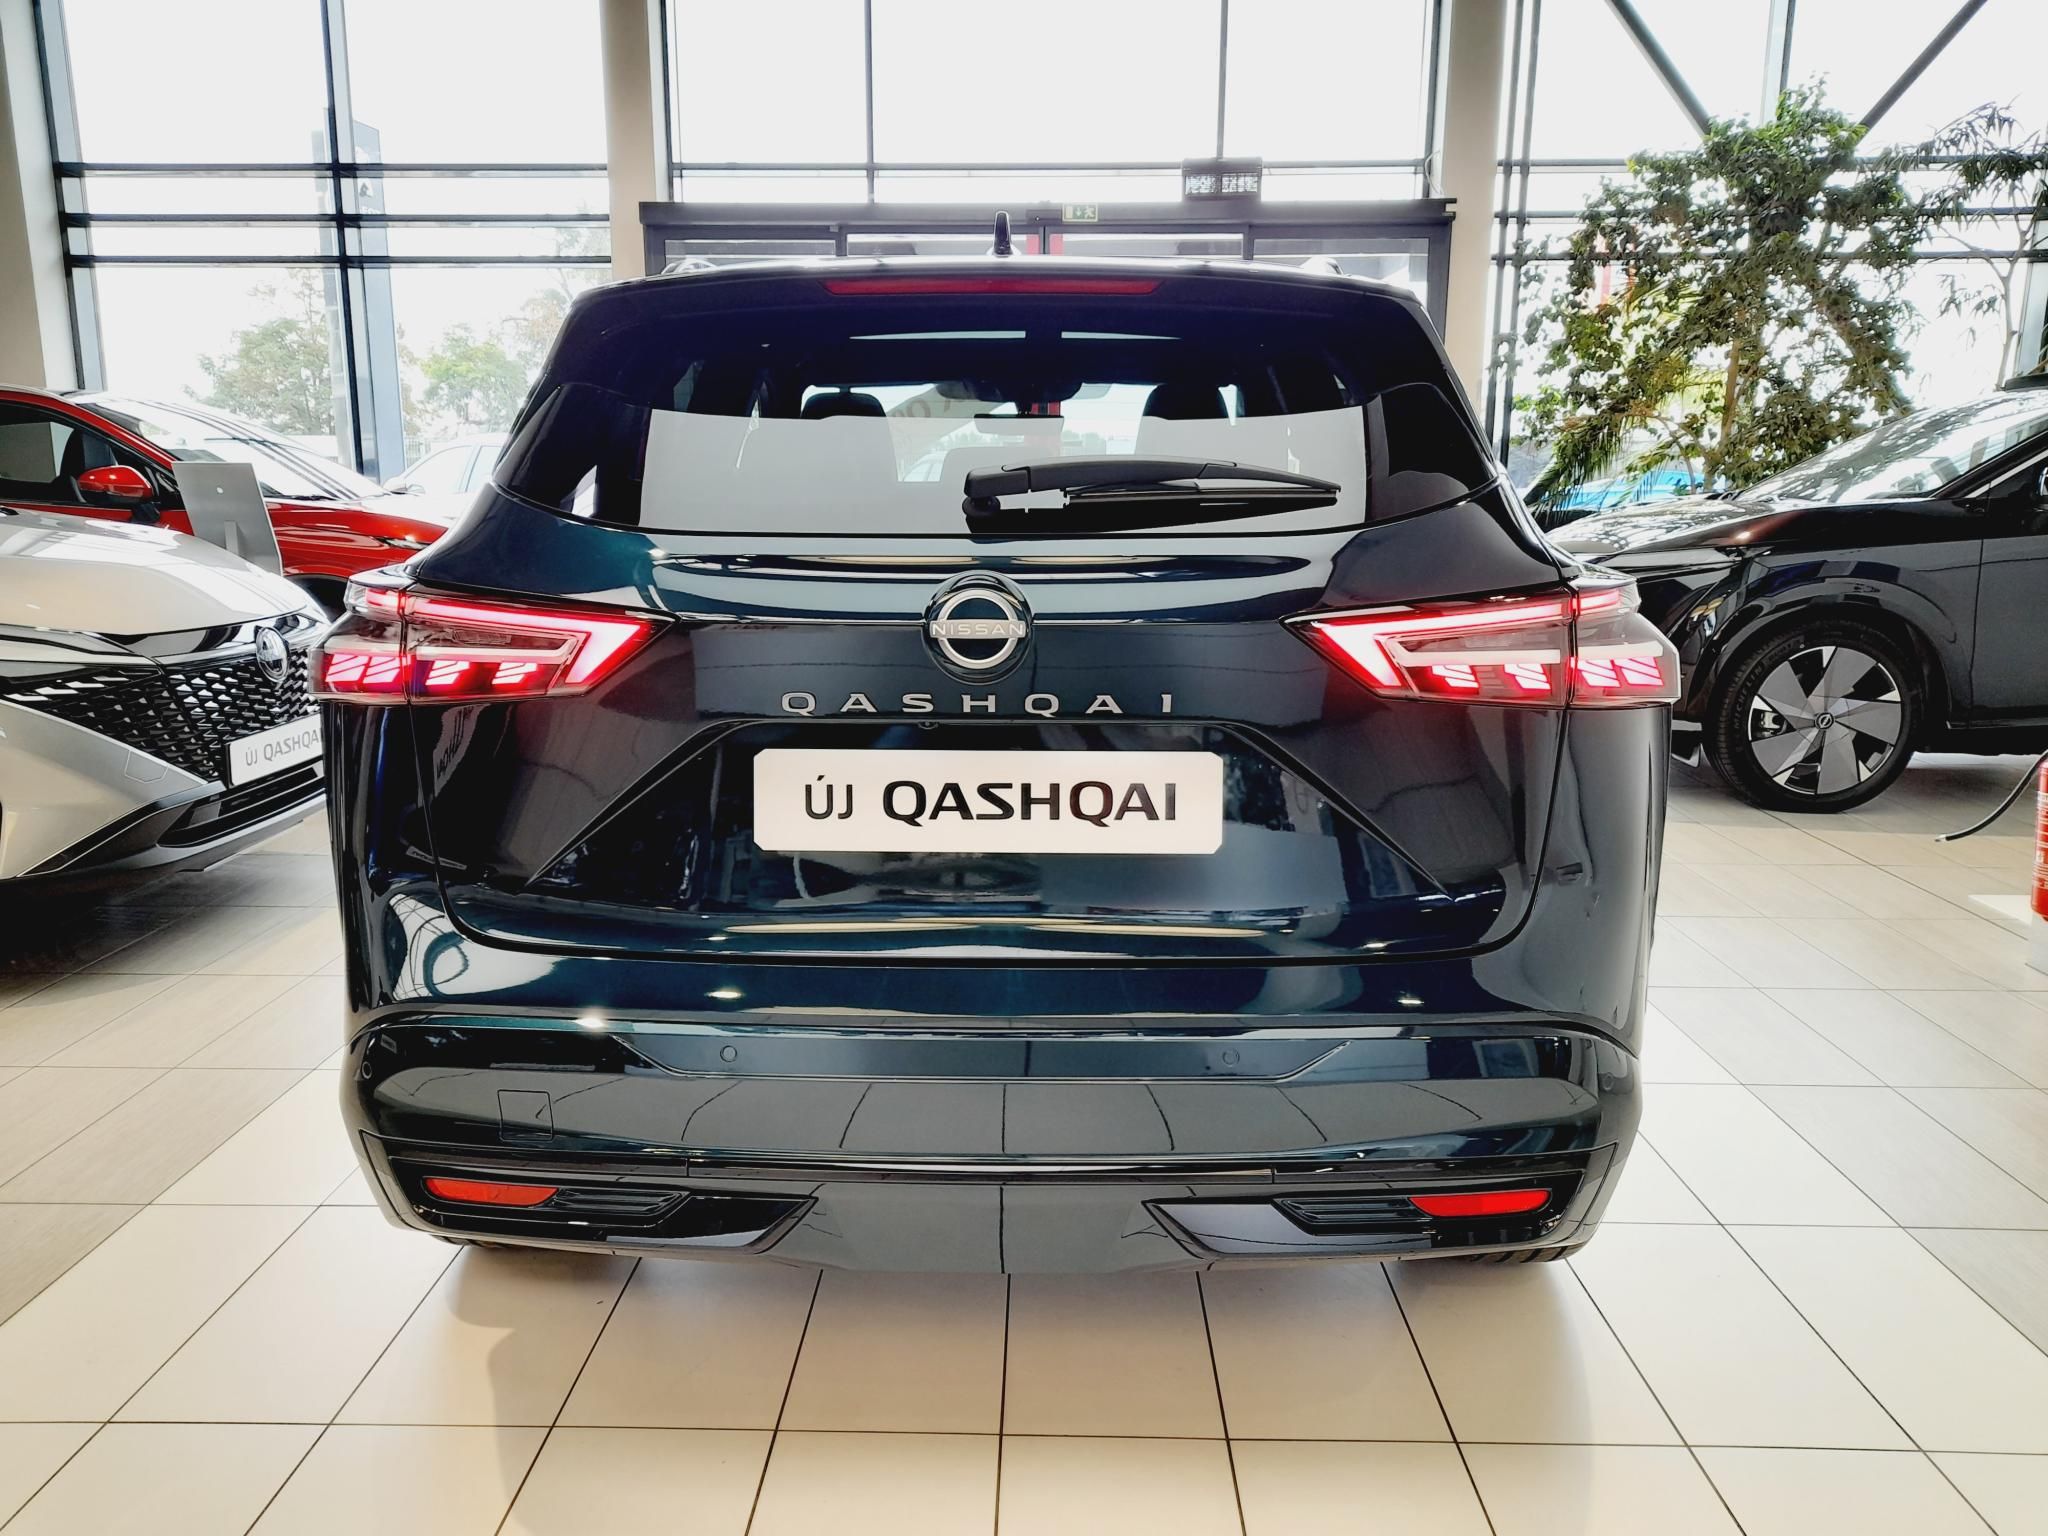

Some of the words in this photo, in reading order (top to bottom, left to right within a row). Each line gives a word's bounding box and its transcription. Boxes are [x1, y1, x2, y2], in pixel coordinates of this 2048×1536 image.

[932, 623, 1023, 636] NISSAN
[781, 692, 1172, 716] QASHQAI
[244, 746, 258, 766] ÚJ
[263, 729, 320, 761] QASHQA
[804, 775, 854, 820] ÚJ
[883, 780, 1177, 827] QASHQAI
